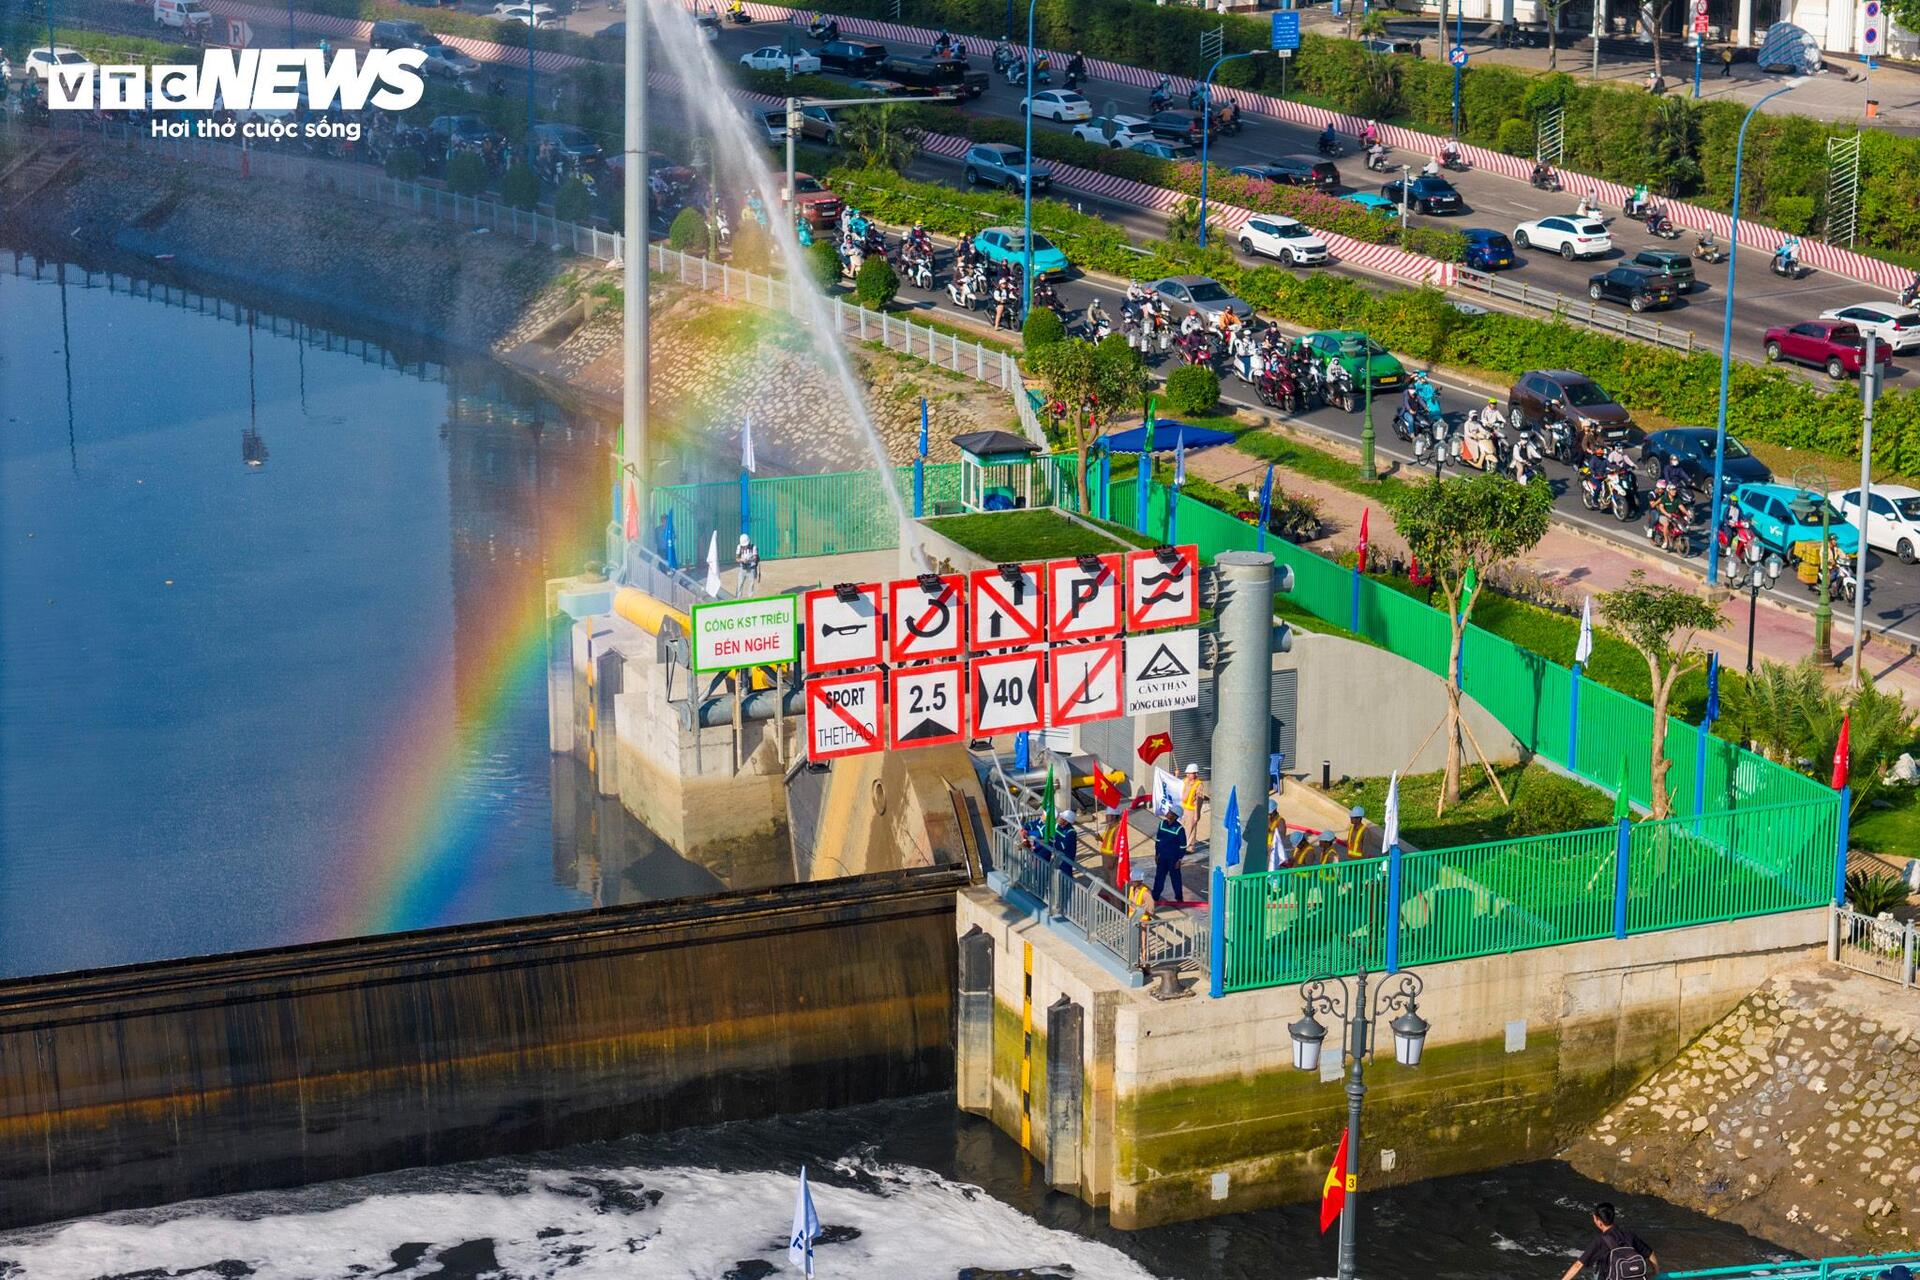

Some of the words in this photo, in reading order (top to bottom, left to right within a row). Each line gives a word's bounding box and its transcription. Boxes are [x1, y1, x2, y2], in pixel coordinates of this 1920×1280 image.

[1072, 578, 1099, 618] P
[737, 615, 758, 628] KST
[744, 632, 781, 652] NGHÉ
[825, 687, 865, 709] SPORT
[909, 682, 947, 714] 2.5
[993, 676, 1023, 707] 40
[817, 722, 875, 747] THETHAO
[1348, 1178, 1356, 1189] 3
